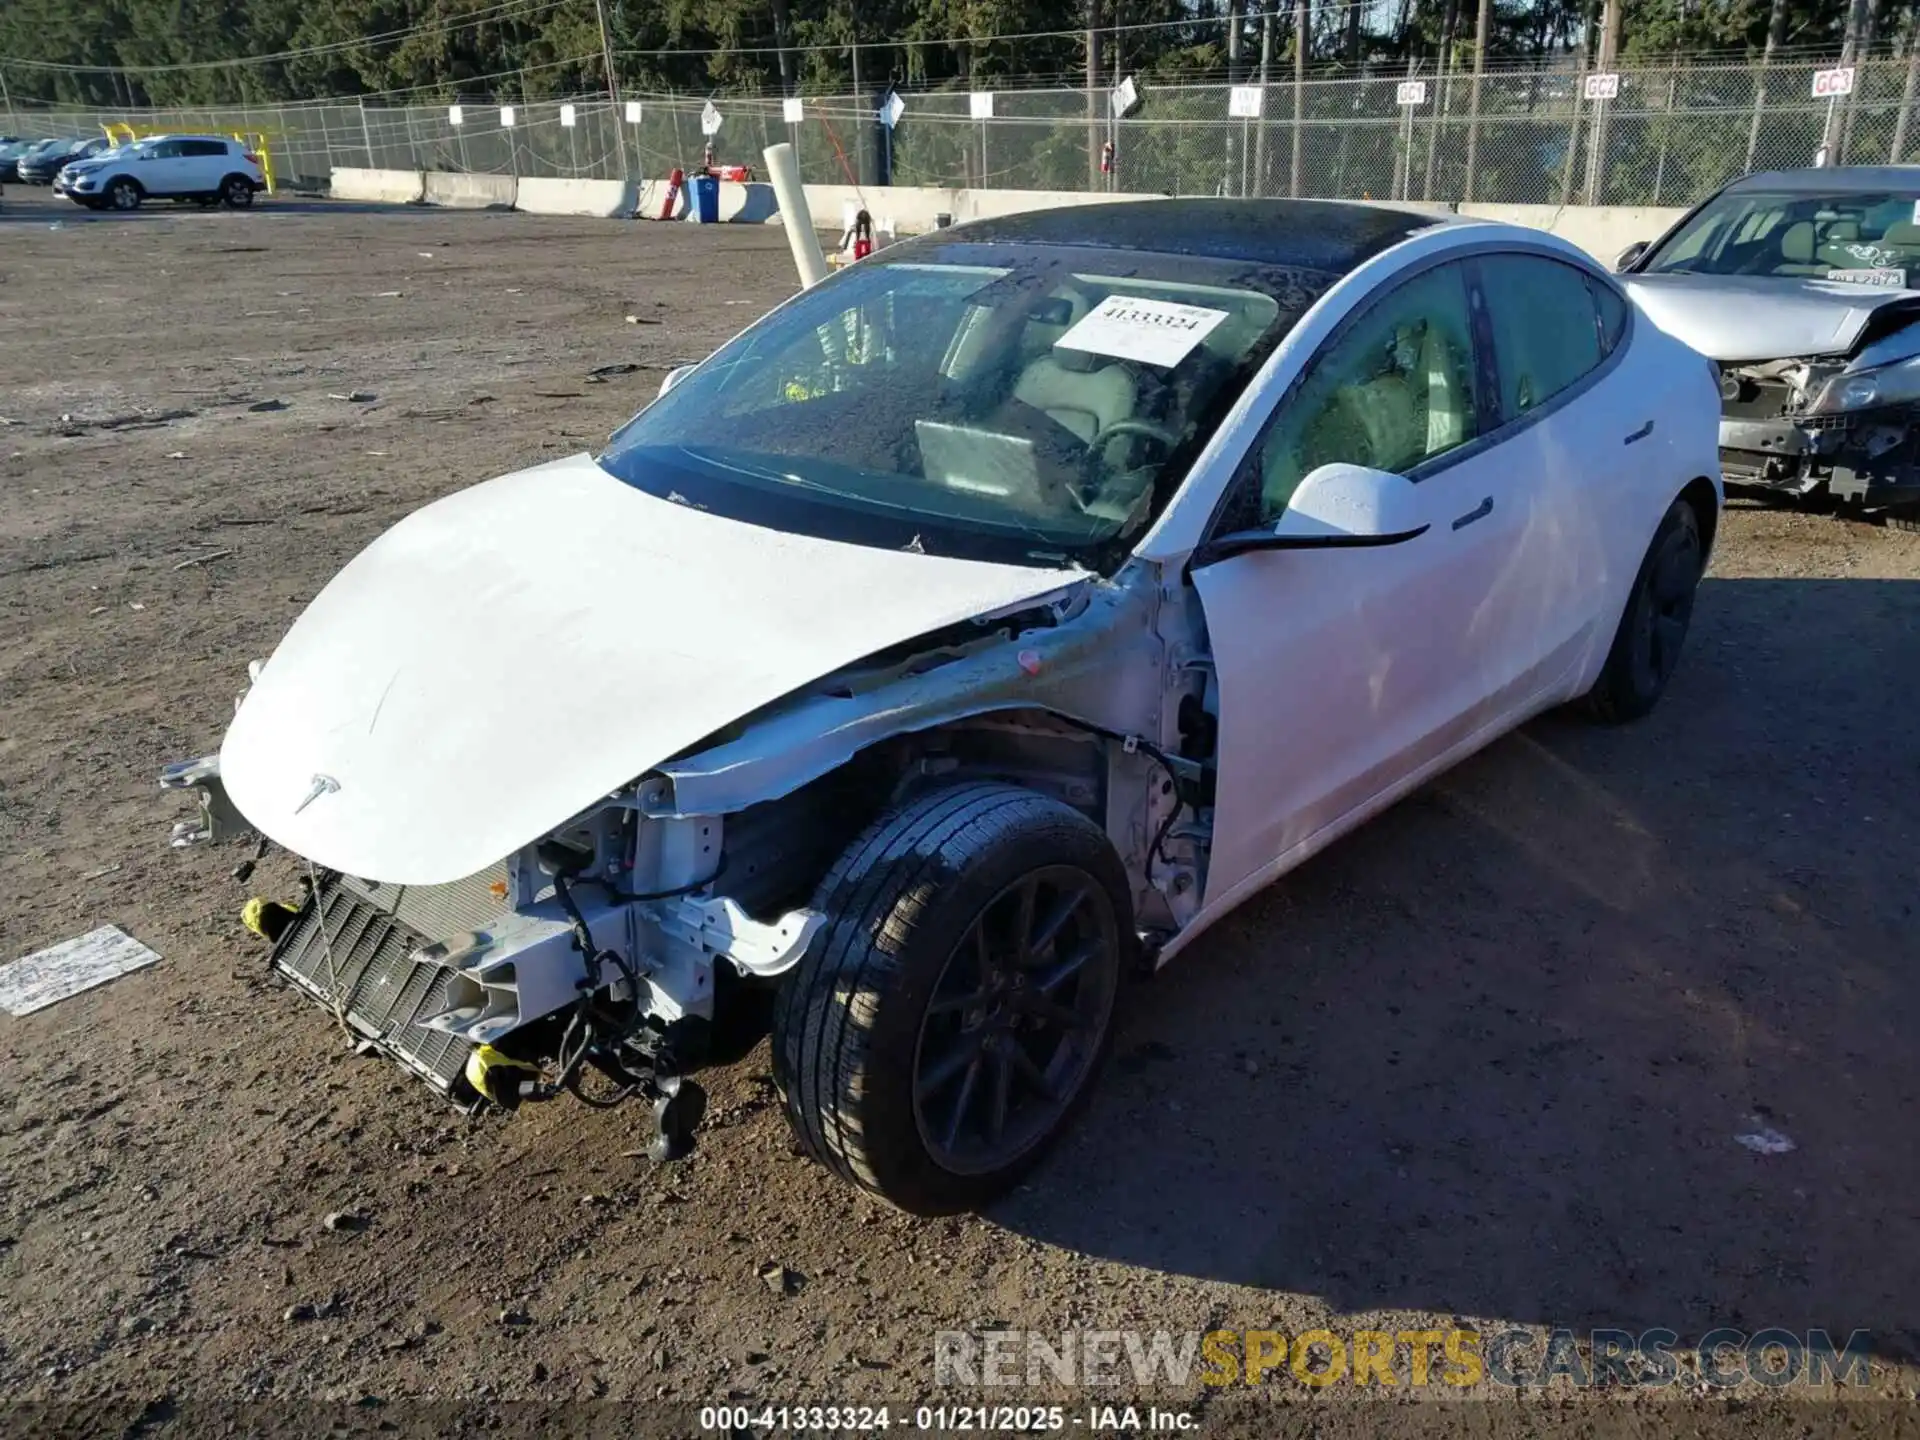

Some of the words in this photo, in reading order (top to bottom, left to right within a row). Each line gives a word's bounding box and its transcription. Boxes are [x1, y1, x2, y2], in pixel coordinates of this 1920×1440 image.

[1588, 78, 1616, 95] GC2
[1816, 71, 1850, 93] GC3
[1400, 84, 1422, 101] GC1
[1103, 308, 1199, 330] 41333324
